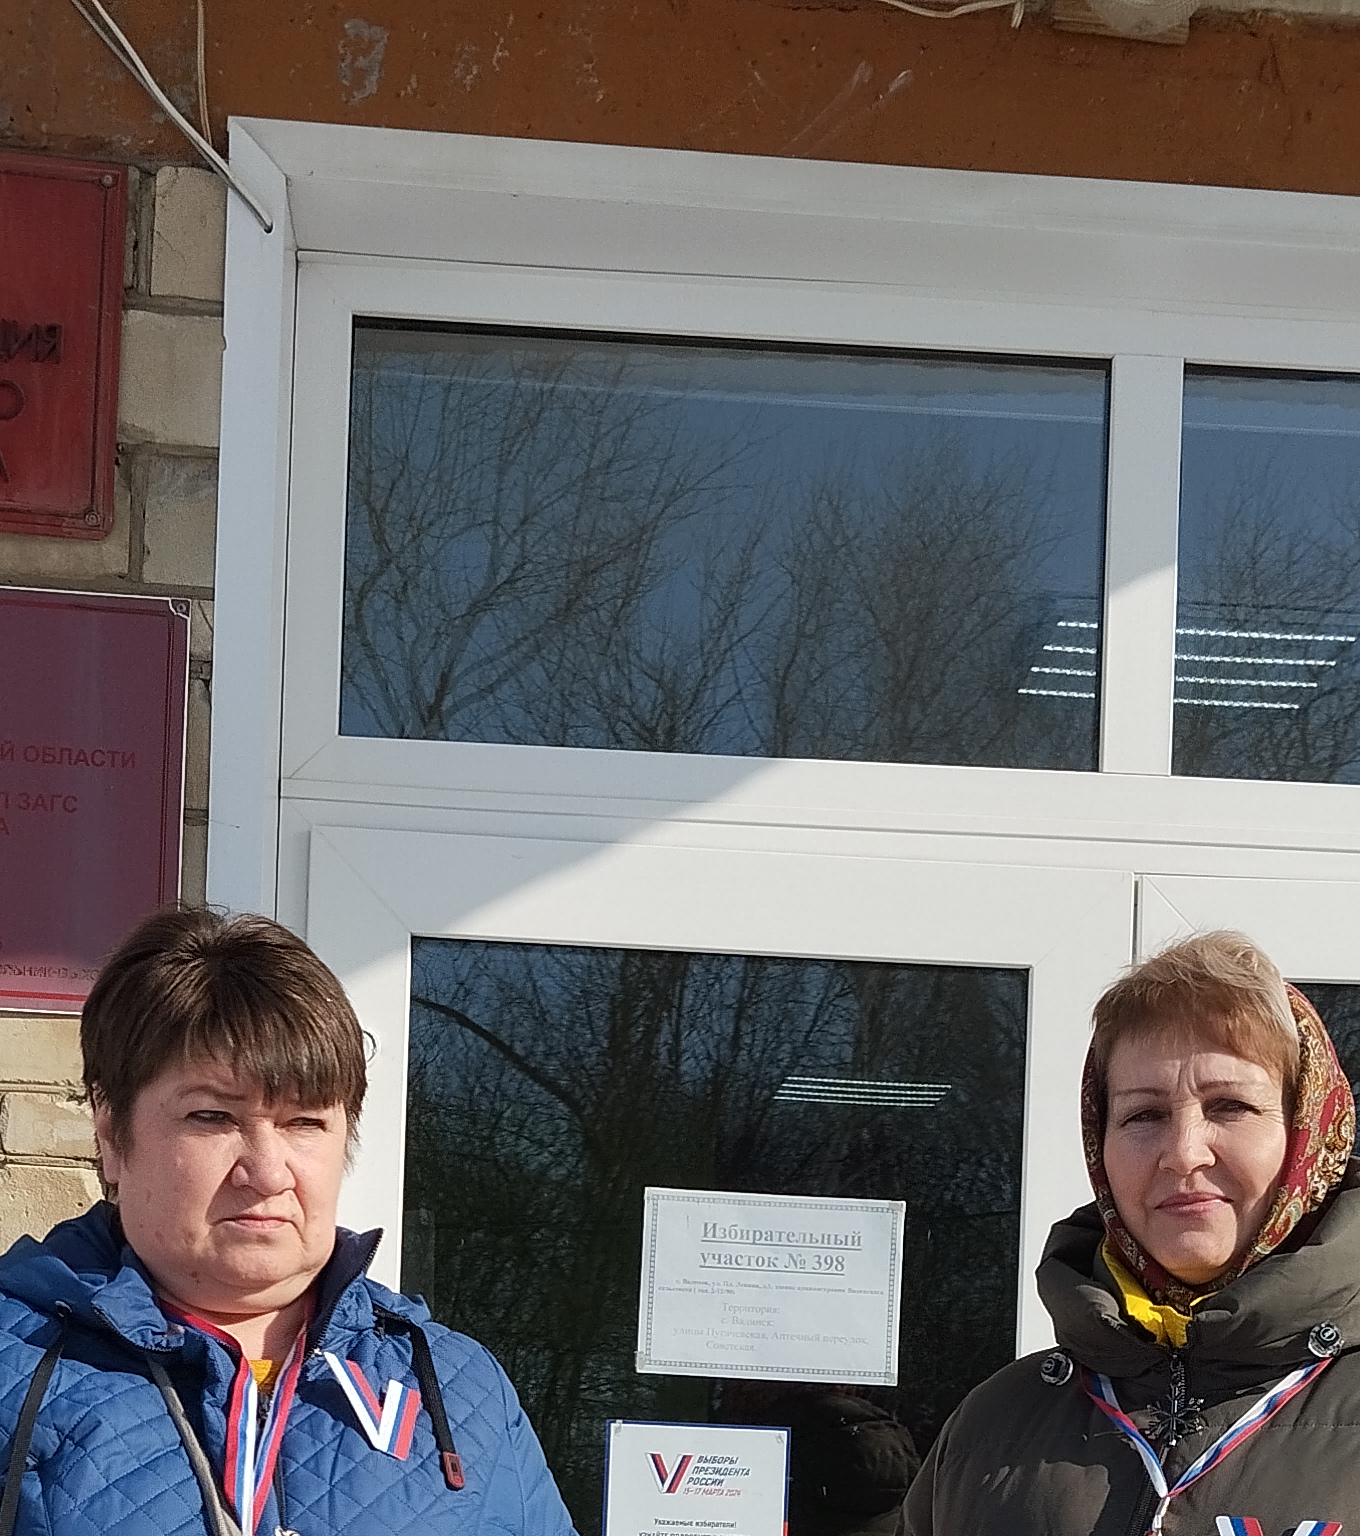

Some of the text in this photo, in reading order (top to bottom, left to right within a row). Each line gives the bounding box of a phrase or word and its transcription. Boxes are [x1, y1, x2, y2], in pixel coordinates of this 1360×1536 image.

[23, 745, 136, 769] ОБЛАСТИ
[17, 790, 78, 814] ЗАГС
[702, 1221, 862, 1248] Избирательный
[699, 1250, 846, 1273] участок № 398
[692, 1465, 751, 1476] ПРЕЗИДЕНТА
[696, 1455, 739, 1465] ВЫБОРЫ
[686, 1476, 725, 1486] РОССИИ
